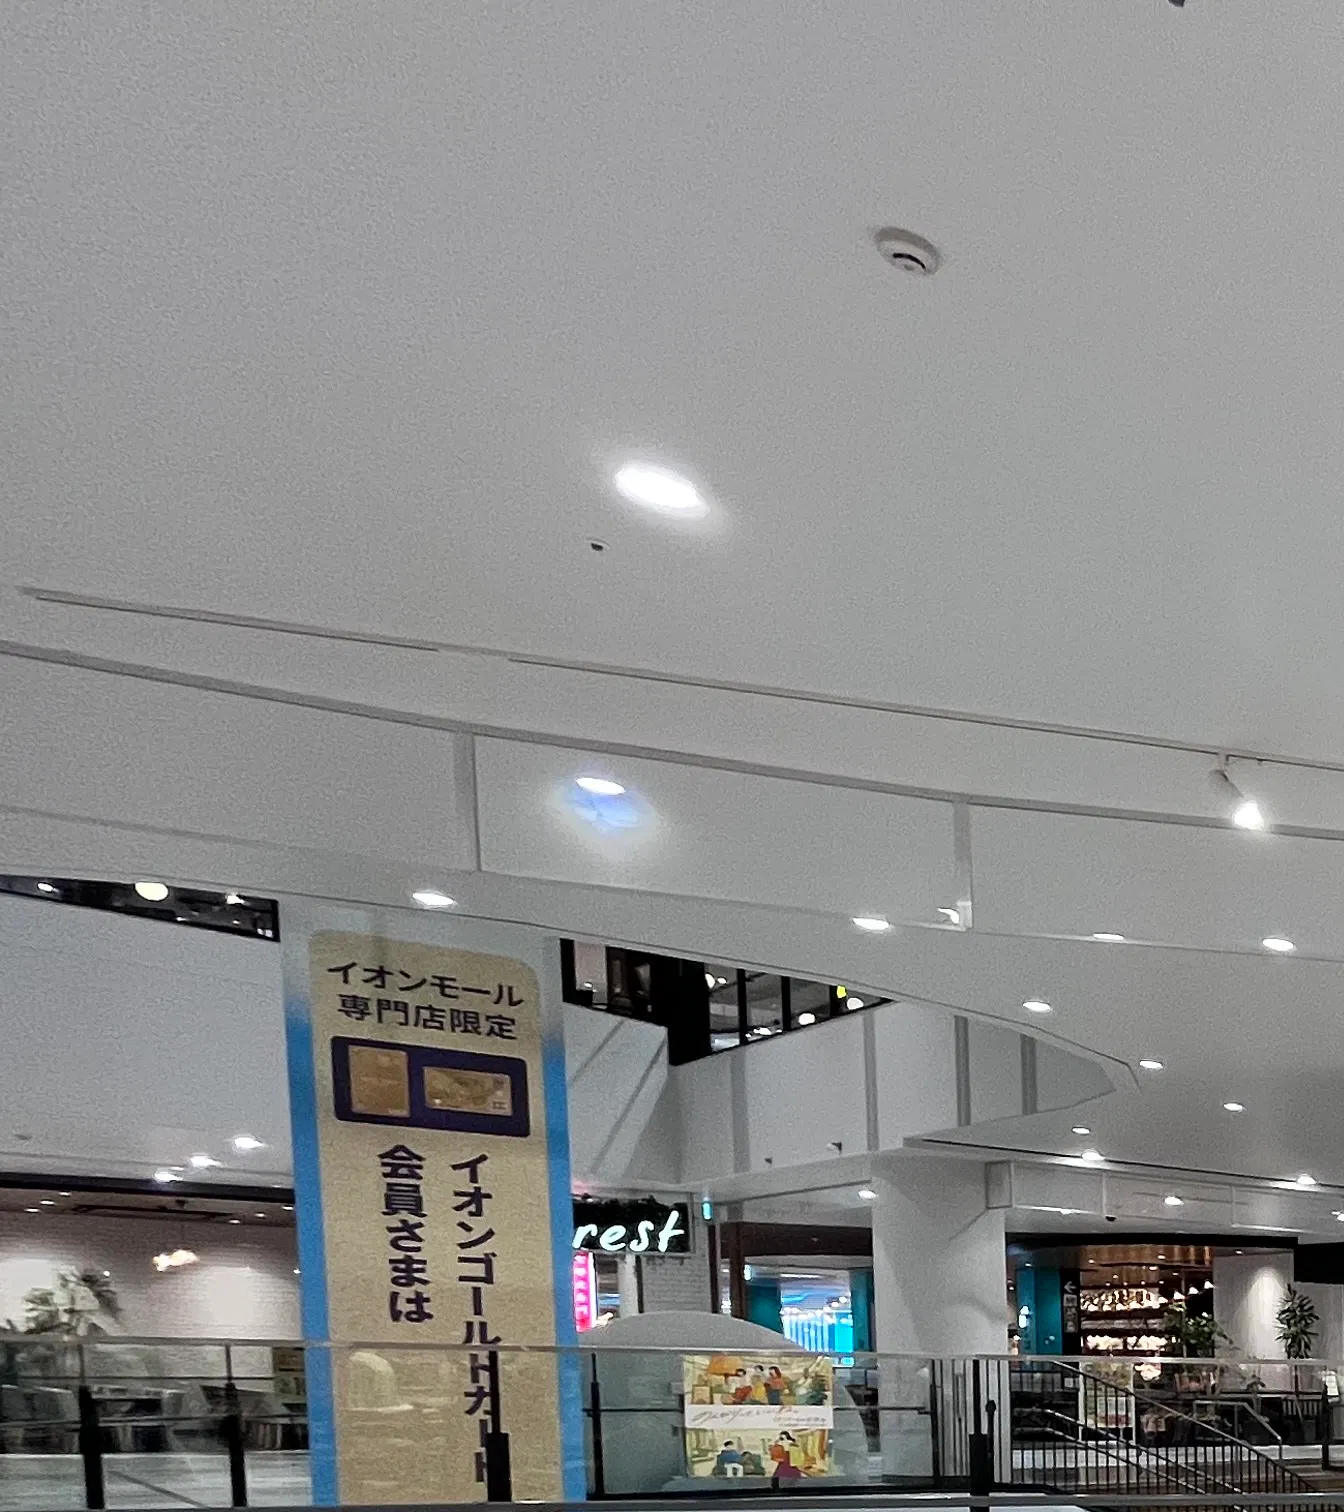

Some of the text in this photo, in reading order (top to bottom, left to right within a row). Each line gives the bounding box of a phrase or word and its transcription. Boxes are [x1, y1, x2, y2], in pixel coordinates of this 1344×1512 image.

[327, 962, 525, 1007] イオンモール
[337, 993, 518, 1040] 専門店限定
[377, 1144, 434, 1323] 会員さまは
